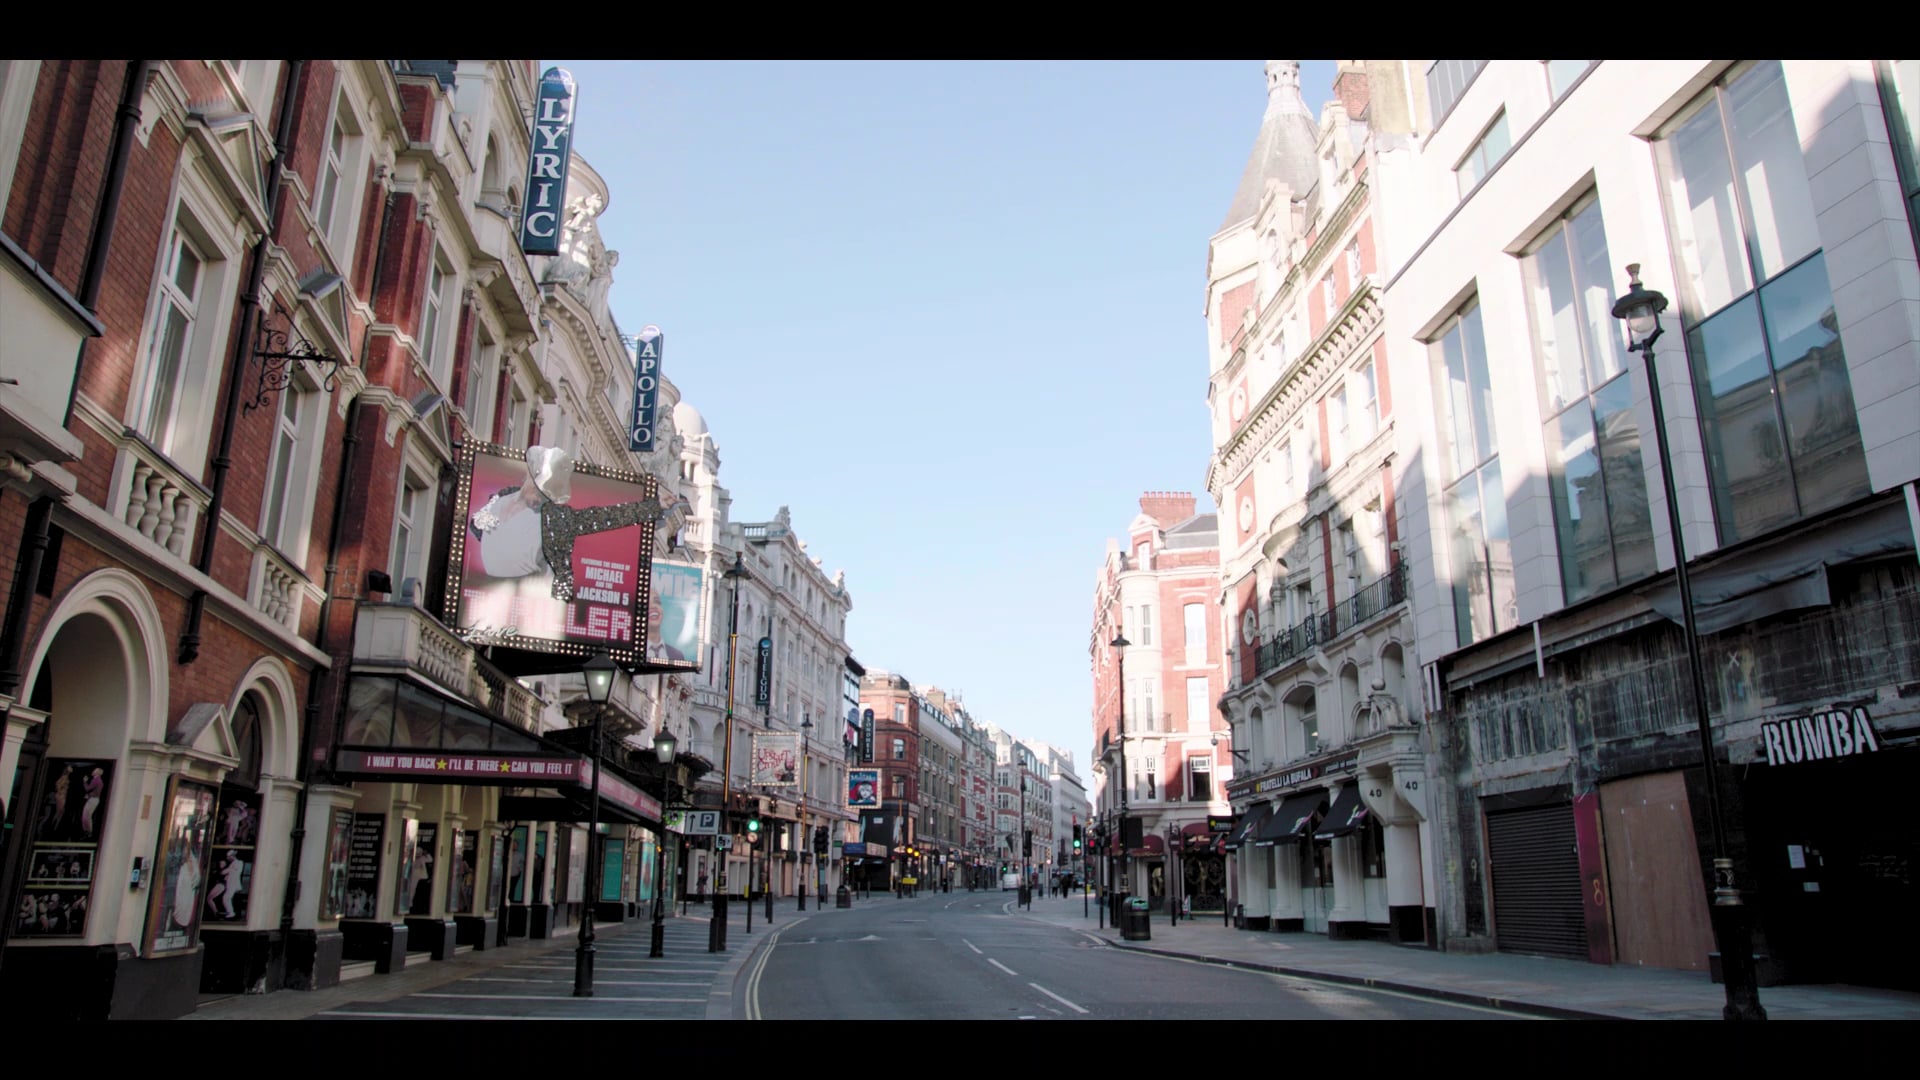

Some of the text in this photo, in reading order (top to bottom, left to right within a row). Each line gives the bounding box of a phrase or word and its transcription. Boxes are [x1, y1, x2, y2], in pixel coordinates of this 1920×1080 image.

[526, 98, 568, 237] LYRIC
[633, 342, 657, 443] APOLLO
[585, 566, 624, 584] MICHAEL
[576, 586, 630, 606] JACKSON 5
[759, 649, 769, 701] GIELGUD
[1762, 706, 1879, 766] RUMBA
[373, 756, 394, 768] WANT
[397, 757, 412, 769] YOU
[414, 757, 436, 769] BACK
[449, 759, 462, 770] I'LL
[464, 760, 473, 771] BE
[476, 760, 499, 772] THERE
[511, 762, 527, 773] CAN
[529, 762, 545, 774] YOU
[547, 762, 562, 775] FEEL
[564, 763, 572, 775] IT
[1260, 776, 1282, 793] FRATELLI
[1283, 774, 1291, 785] LA
[1405, 781, 1418, 790] 40
[1369, 789, 1382, 798] 40
[702, 814, 713, 826] P
[1593, 879, 1604, 906] 8
